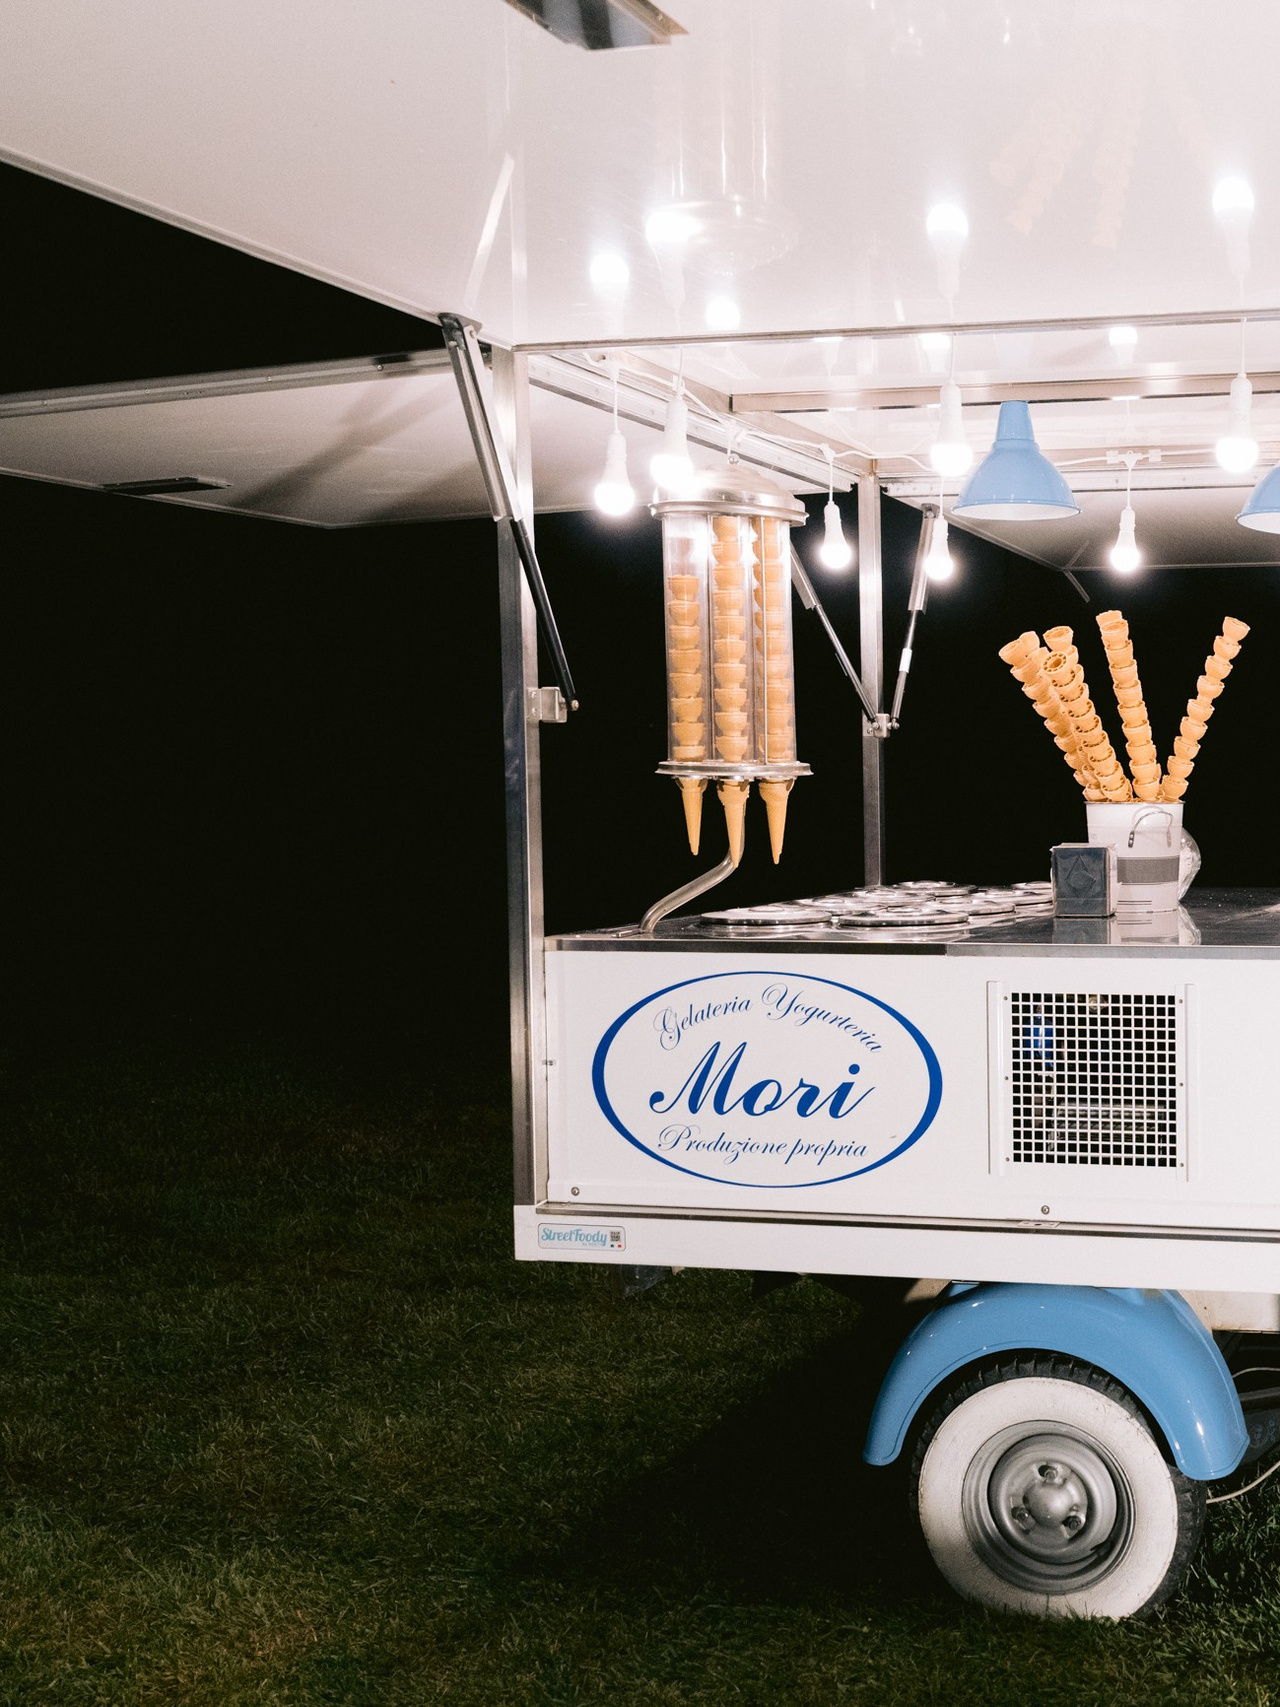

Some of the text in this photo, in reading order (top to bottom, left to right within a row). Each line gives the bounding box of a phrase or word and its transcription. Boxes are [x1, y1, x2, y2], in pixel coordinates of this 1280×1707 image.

[653, 982, 883, 1053] Gelateria Yogurteria
[649, 1040, 876, 1119] Mori
[657, 1123, 869, 1166] Produzione propria
